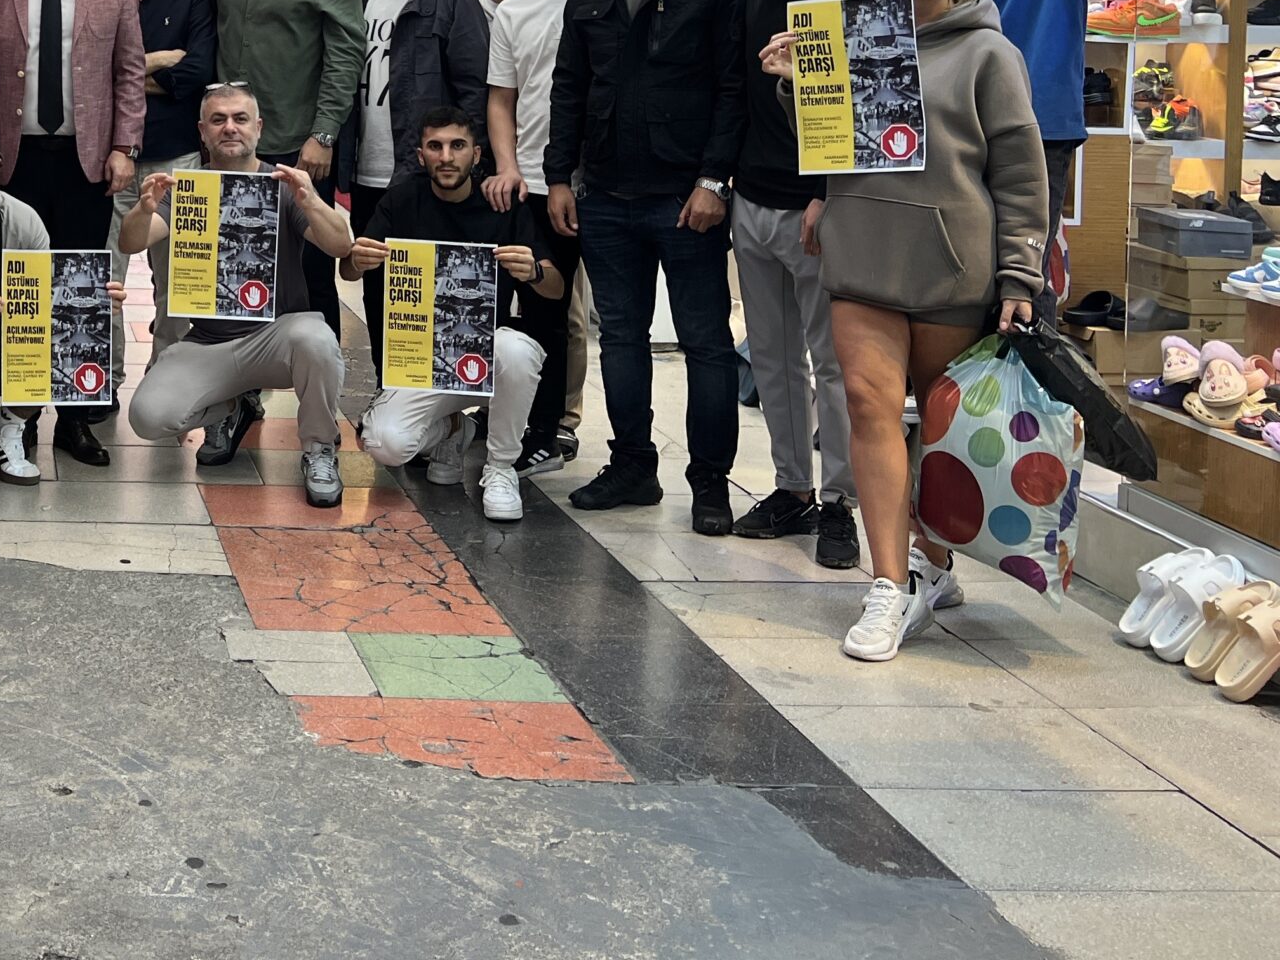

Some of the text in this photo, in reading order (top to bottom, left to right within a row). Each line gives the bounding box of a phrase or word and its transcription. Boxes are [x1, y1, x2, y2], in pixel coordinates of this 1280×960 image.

[793, 12, 812, 29] ADI
[796, 43, 832, 57] KAPALI
[798, 57, 835, 78] ÇARŞI
[177, 179, 194, 193] ADI
[176, 194, 208, 206] ÜSTÜNDE
[176, 206, 207, 218] KAPALI
[175, 218, 207, 236] ÇARŞI
[390, 249, 408, 263] ADI
[7, 261, 25, 274] ADI
[389, 265, 423, 277] ÜSTÜNDE
[7, 276, 39, 287] ÜSTÜNDE
[389, 276, 422, 289] KAPALI
[7, 289, 39, 301] KAPALI
[389, 289, 422, 308] ÇARŞI
[7, 302, 39, 320] ÇARŞI
